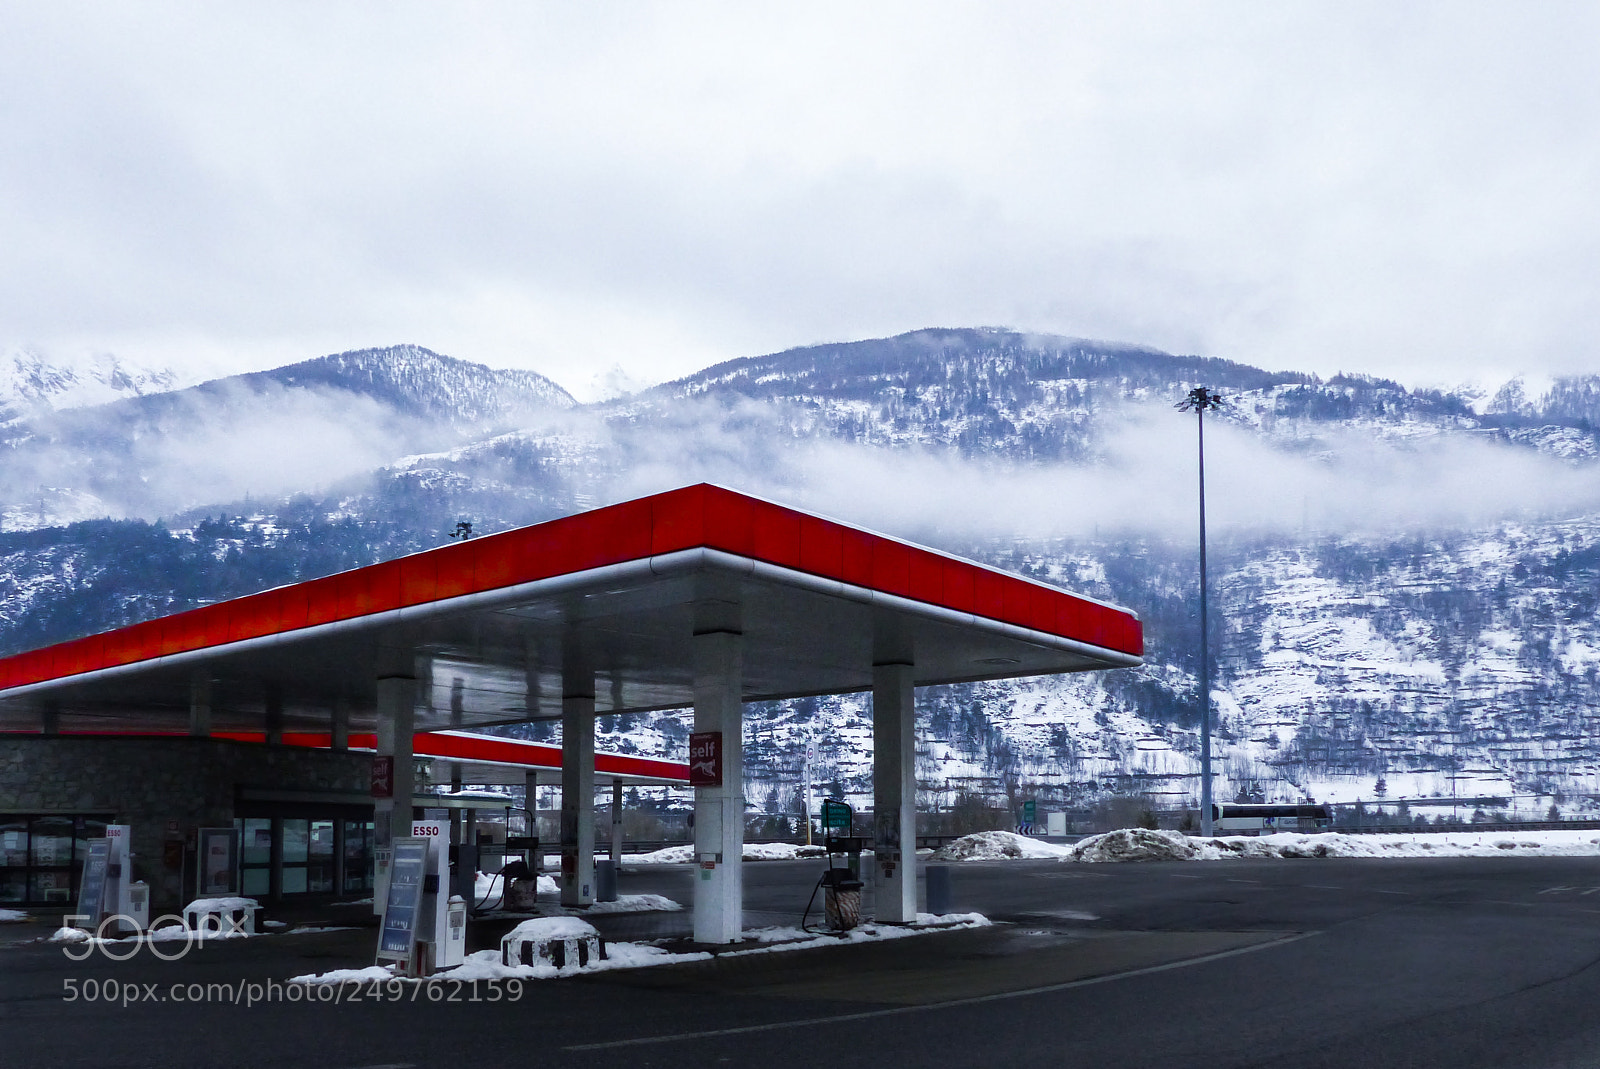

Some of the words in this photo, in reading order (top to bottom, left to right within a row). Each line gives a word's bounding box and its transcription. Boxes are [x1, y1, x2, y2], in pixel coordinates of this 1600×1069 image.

[691, 741, 715, 758] self
[373, 763, 388, 775] self
[107, 829, 121, 837] ESSO
[413, 826, 439, 836] ESSO
